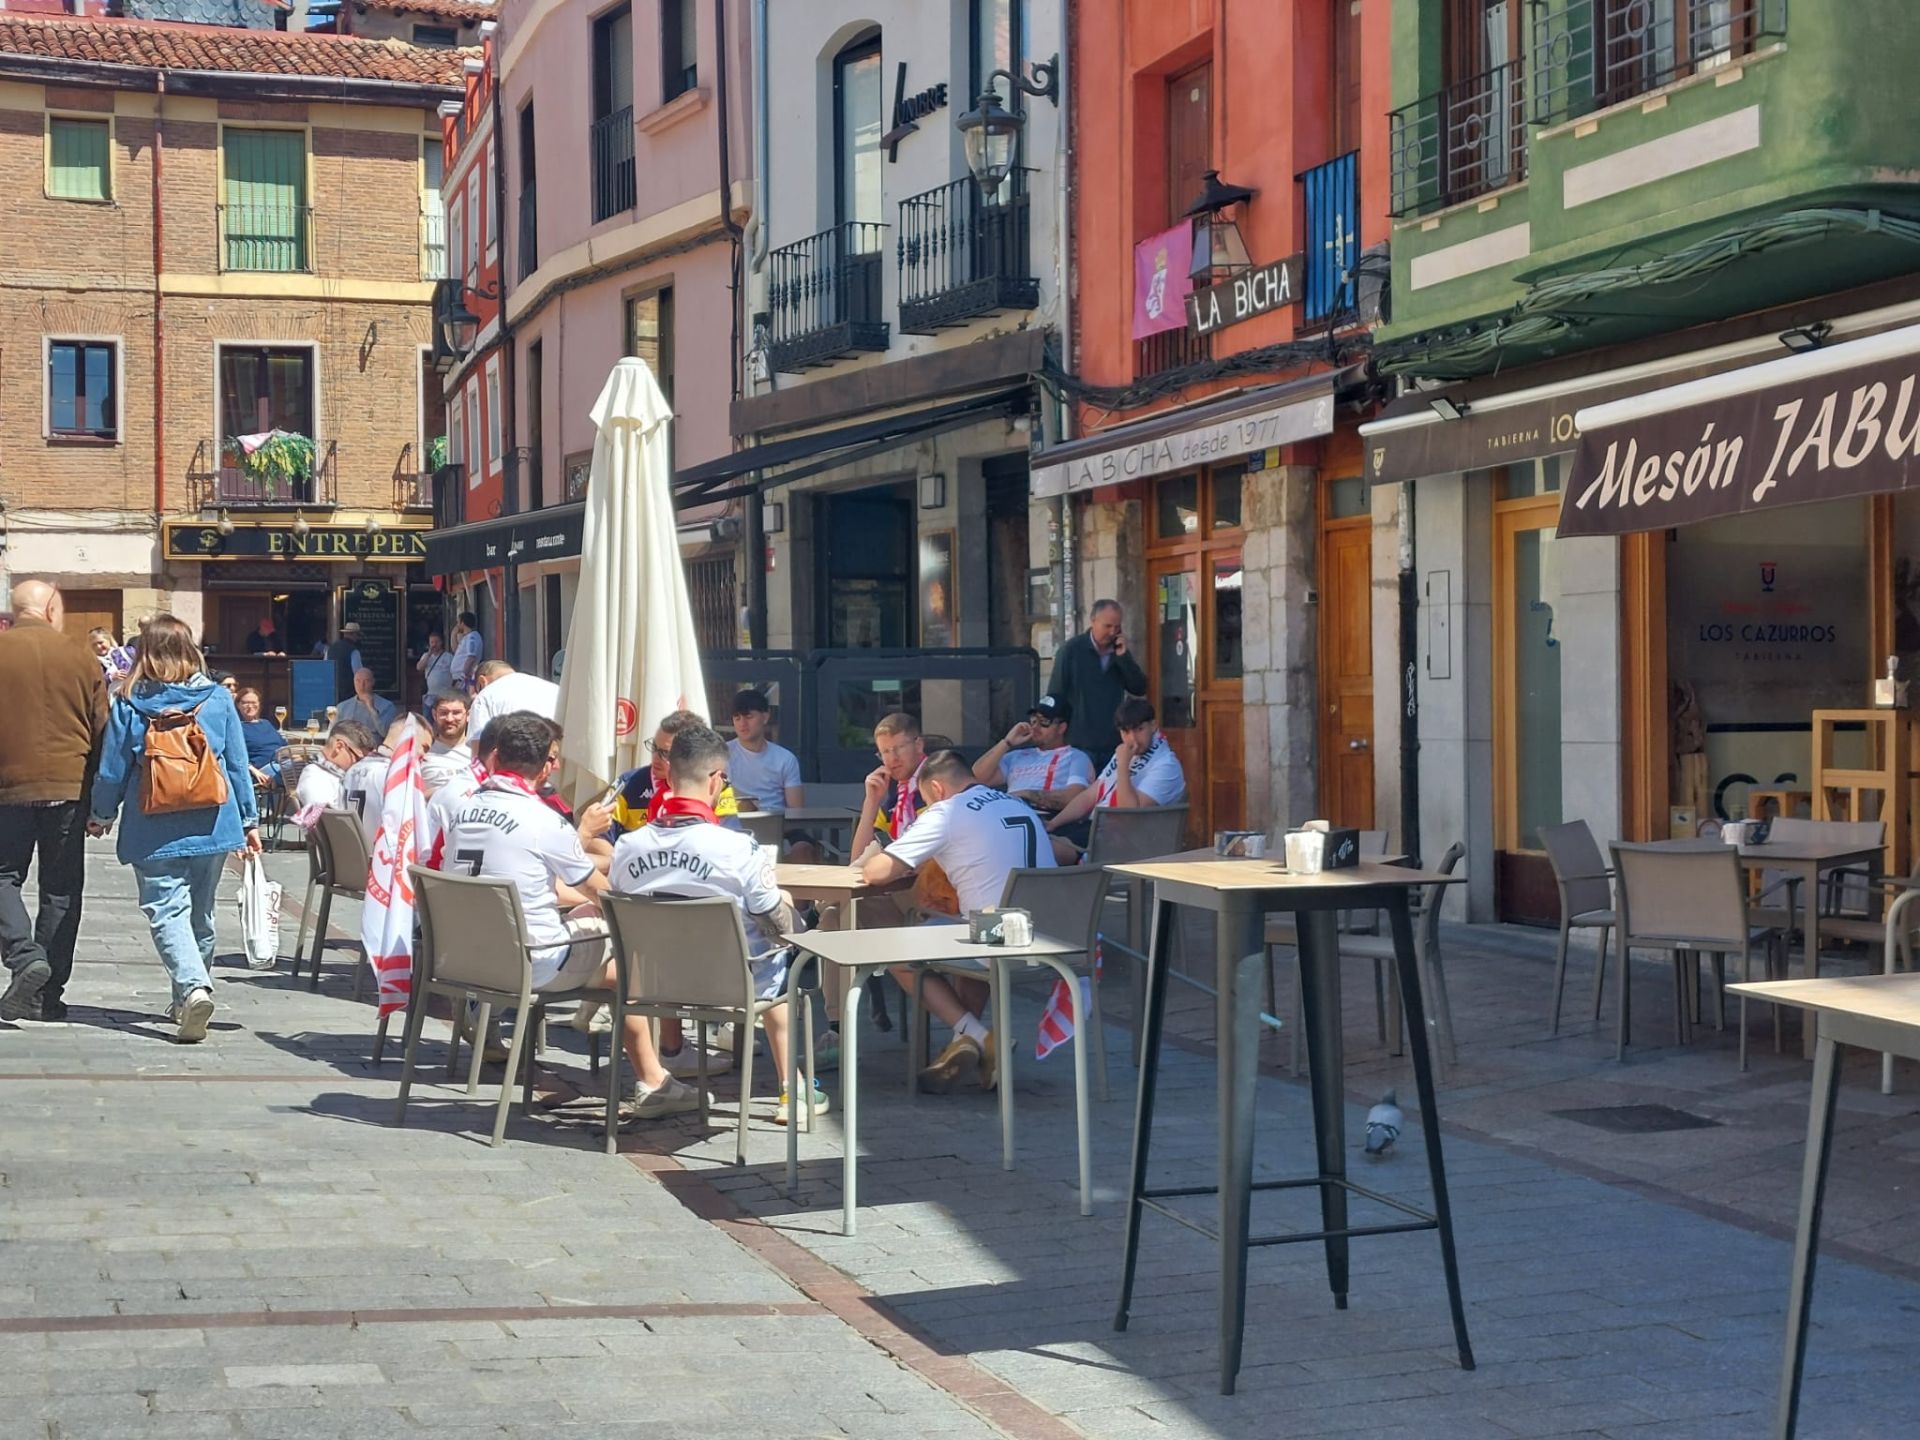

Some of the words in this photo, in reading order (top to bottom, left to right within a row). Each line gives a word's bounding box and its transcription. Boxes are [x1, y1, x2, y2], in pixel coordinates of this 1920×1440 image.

[1193, 290, 1222, 332] LA
[1065, 461, 1094, 490] LA
[1182, 432, 1229, 461] desde
[1236, 415, 1280, 447] 1977
[1575, 422, 1744, 509] Mesón
[1699, 624, 1734, 642] LOS
[1741, 624, 1837, 643] CAZURROS
[627, 850, 714, 882] CALDERÓN
[1001, 815, 1038, 869] 7
